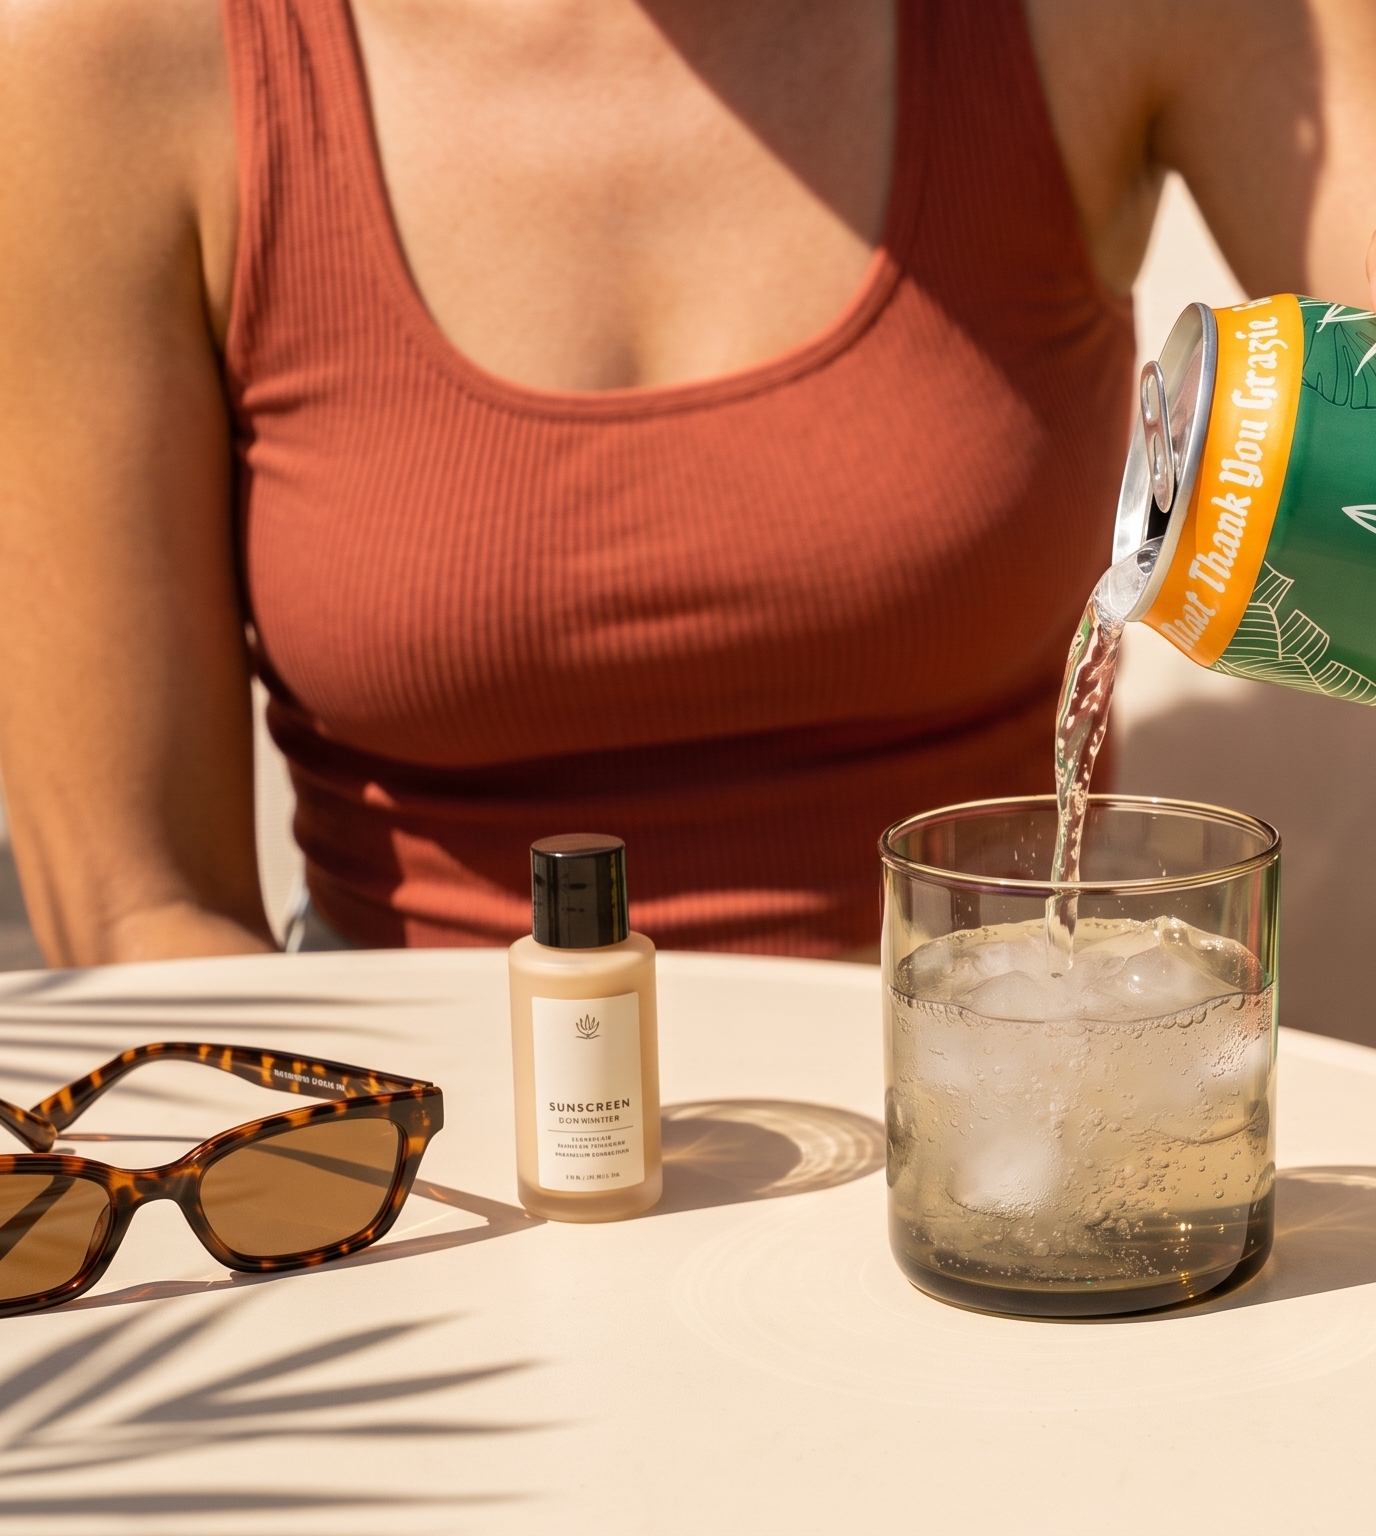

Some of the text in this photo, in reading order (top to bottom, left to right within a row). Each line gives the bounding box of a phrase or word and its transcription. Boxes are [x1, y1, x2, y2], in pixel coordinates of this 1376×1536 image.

[1188, 492, 1252, 593] Thank
[1231, 316, 1288, 410] Grazie
[549, 1098, 630, 1113] SUNSCREEN
